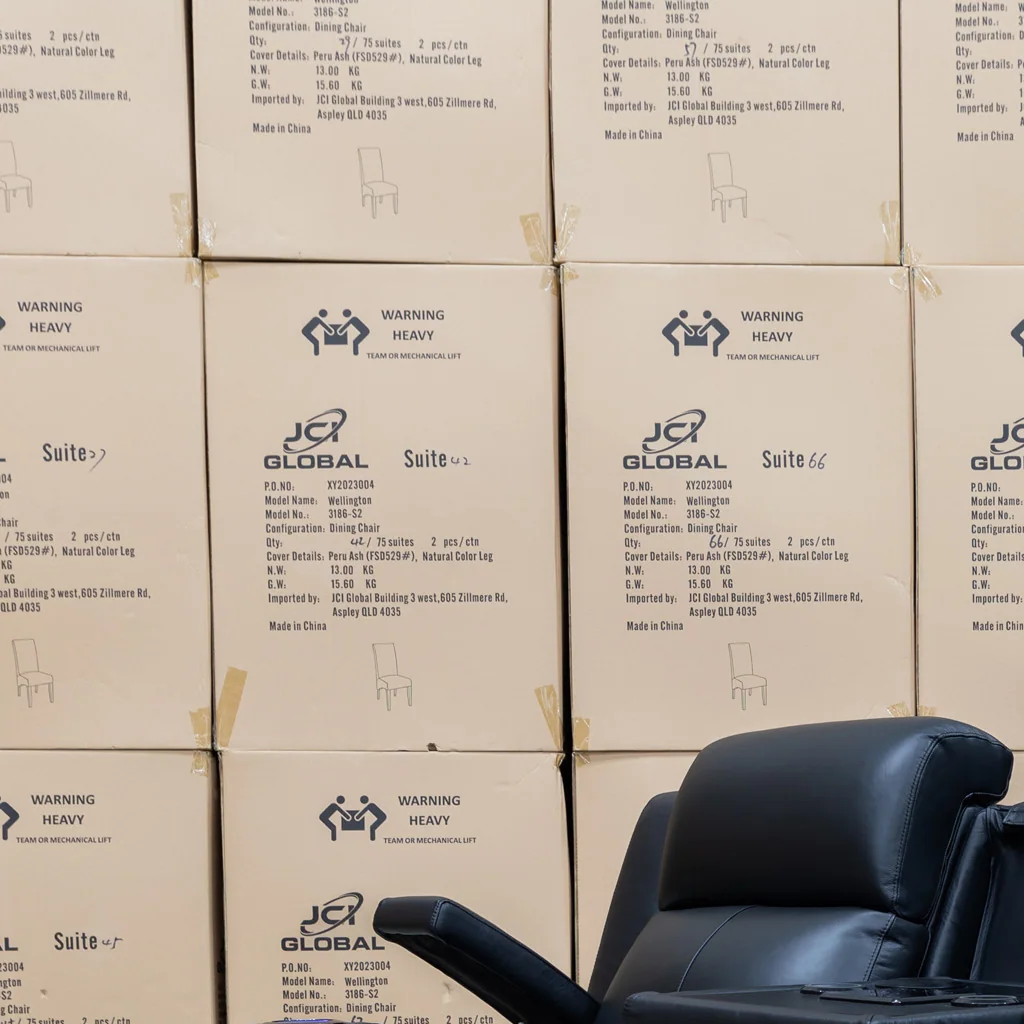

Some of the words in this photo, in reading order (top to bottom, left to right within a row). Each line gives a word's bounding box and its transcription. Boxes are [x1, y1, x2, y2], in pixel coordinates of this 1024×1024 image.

[248, 5, 274, 16] Model
[314, 6, 349, 18] 3186-S2
[955, 2, 980, 13] Model
[40, 46, 73, 56] Natural
[75, 46, 97, 57] Color
[99, 46, 115, 59] Leg
[667, 71, 690, 82] 13.00
[699, 71, 710, 82] KG
[604, 101, 642, 113] Imported
[668, 100, 680, 111] JCI
[682, 100, 708, 111] Global
[710, 100, 745, 113] Building
[746, 100, 752, 111] 3
[794, 100, 829, 111] Zillmere
[253, 122, 275, 133] Made
[277, 123, 285, 133] in
[287, 123, 311, 134] China
[17, 301, 82, 313] WARNING
[381, 310, 444, 320] WARNING
[741, 311, 803, 322] WARNING
[30, 322, 72, 333] HEAVY
[393, 330, 434, 341] HEAVY
[752, 331, 793, 342] HEAVY
[400, 352, 446, 360] MECHANICAL
[42, 443, 87, 462] Suite
[404, 449, 447, 468] Suite
[451, 456, 471, 465] 42
[264, 454, 369, 470] GLOBAL
[623, 454, 727, 470] GLOBAL
[762, 450, 804, 469] Suite
[808, 452, 827, 470] 66
[327, 479, 374, 490] XY2023004
[265, 495, 289, 506] Model
[328, 495, 372, 507] Wellington
[265, 509, 290, 520] Model
[328, 508, 362, 519] 3186-S2
[329, 523, 357, 535] Dining
[358, 522, 380, 533] Chair
[376, 537, 387, 547] 75
[388, 537, 414, 547] suites
[431, 536, 436, 547] 2
[266, 551, 290, 562] Cover
[328, 551, 347, 561] Peru
[349, 551, 364, 561] Ash
[422, 551, 453, 561] Natural
[455, 551, 477, 561] Color
[479, 551, 493, 563] Leg
[330, 564, 354, 575] 13.00
[362, 565, 374, 575] KG
[331, 579, 354, 589] 15.60
[365, 578, 377, 589] KG
[268, 593, 306, 605] Imported
[331, 592, 344, 603] JCI
[346, 592, 372, 603] Global
[374, 593, 409, 605] Building
[410, 592, 416, 603] 3
[458, 592, 493, 602] Zillmere
[332, 607, 360, 619] Aspley
[361, 606, 378, 617] QLD
[380, 606, 401, 617] 4035
[269, 621, 291, 631] Made
[293, 621, 301, 631] in
[303, 620, 327, 631] China
[31, 794, 95, 805] WARNING
[398, 795, 460, 806] WARNING
[43, 814, 84, 825] HEAVY
[409, 815, 450, 826] HEAVY
[54, 932, 97, 951] Suite
[281, 936, 386, 951] GLOBAL
[344, 961, 391, 971] XY2023004
[282, 976, 307, 986] Model
[344, 976, 388, 988] Wellington
